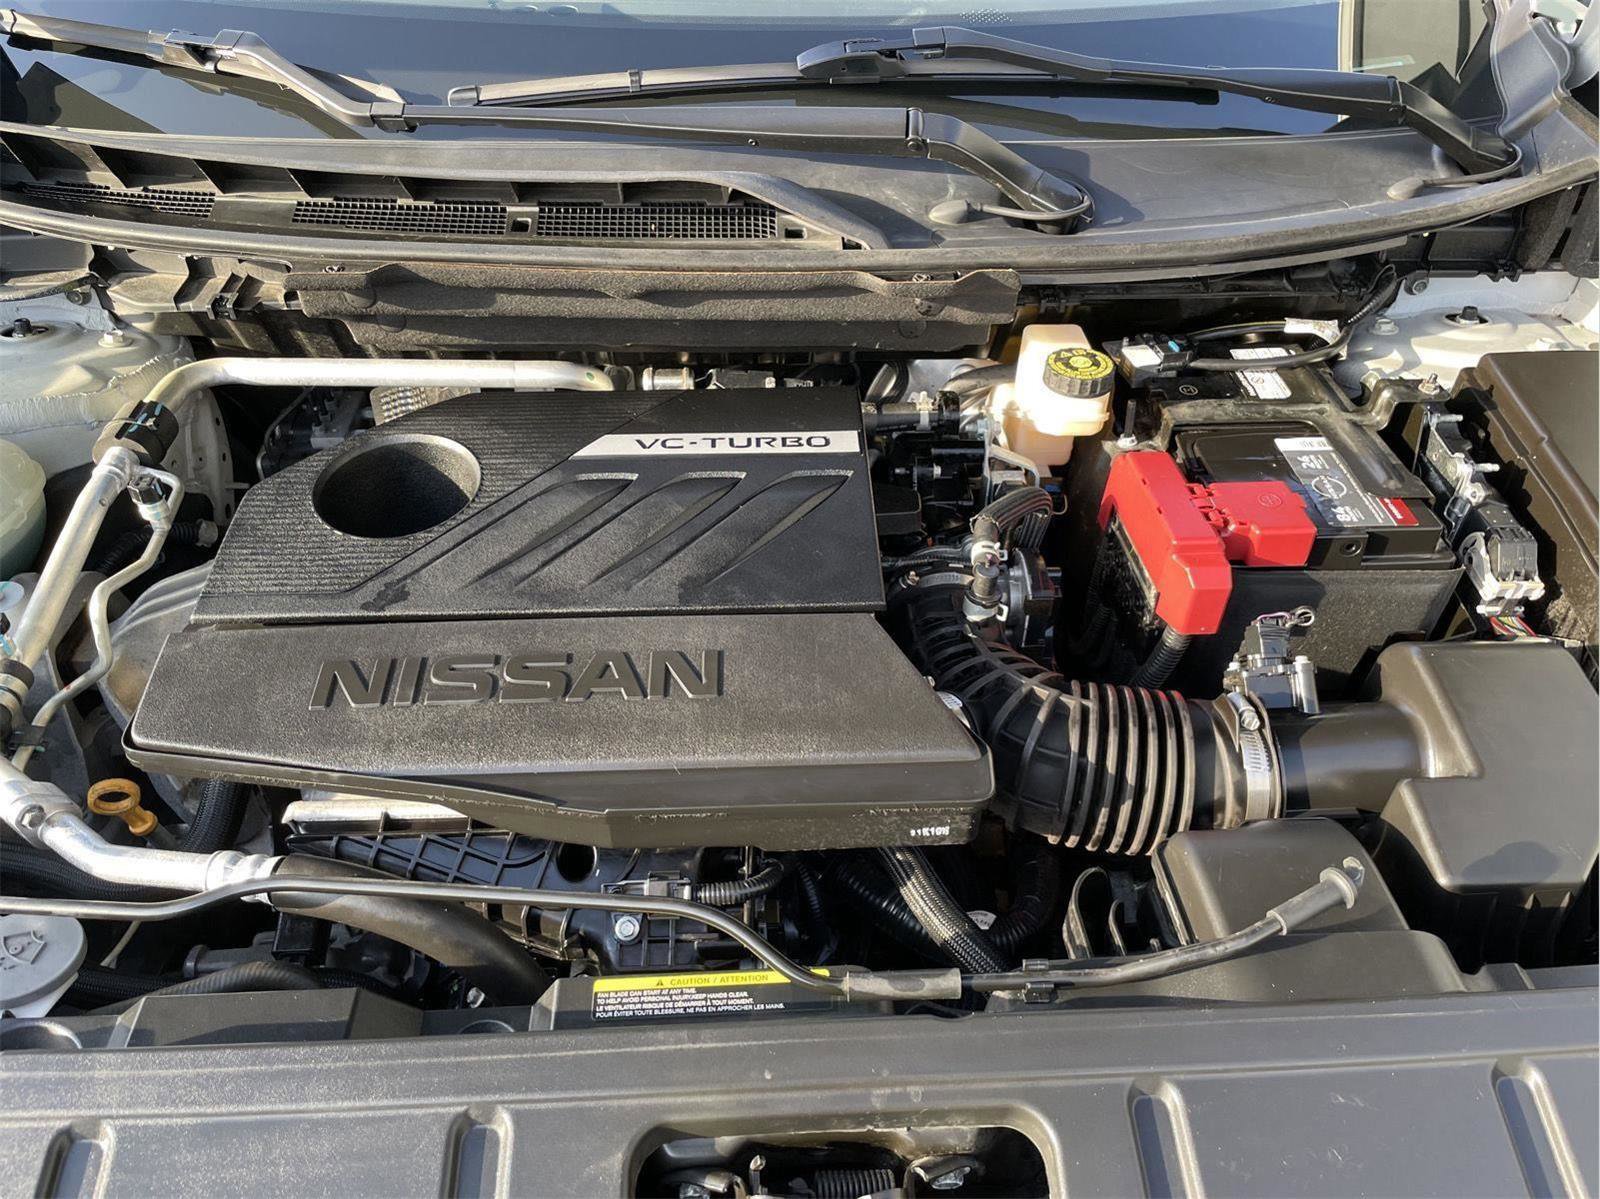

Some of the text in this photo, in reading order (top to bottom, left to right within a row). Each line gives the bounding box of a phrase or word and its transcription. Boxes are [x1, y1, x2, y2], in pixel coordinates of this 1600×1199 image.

[635, 435, 832, 450] VC-TURBO
[308, 650, 724, 710] NISSAN
[670, 977, 710, 986] CAUTION
[719, 974, 769, 984] ATTENTION
